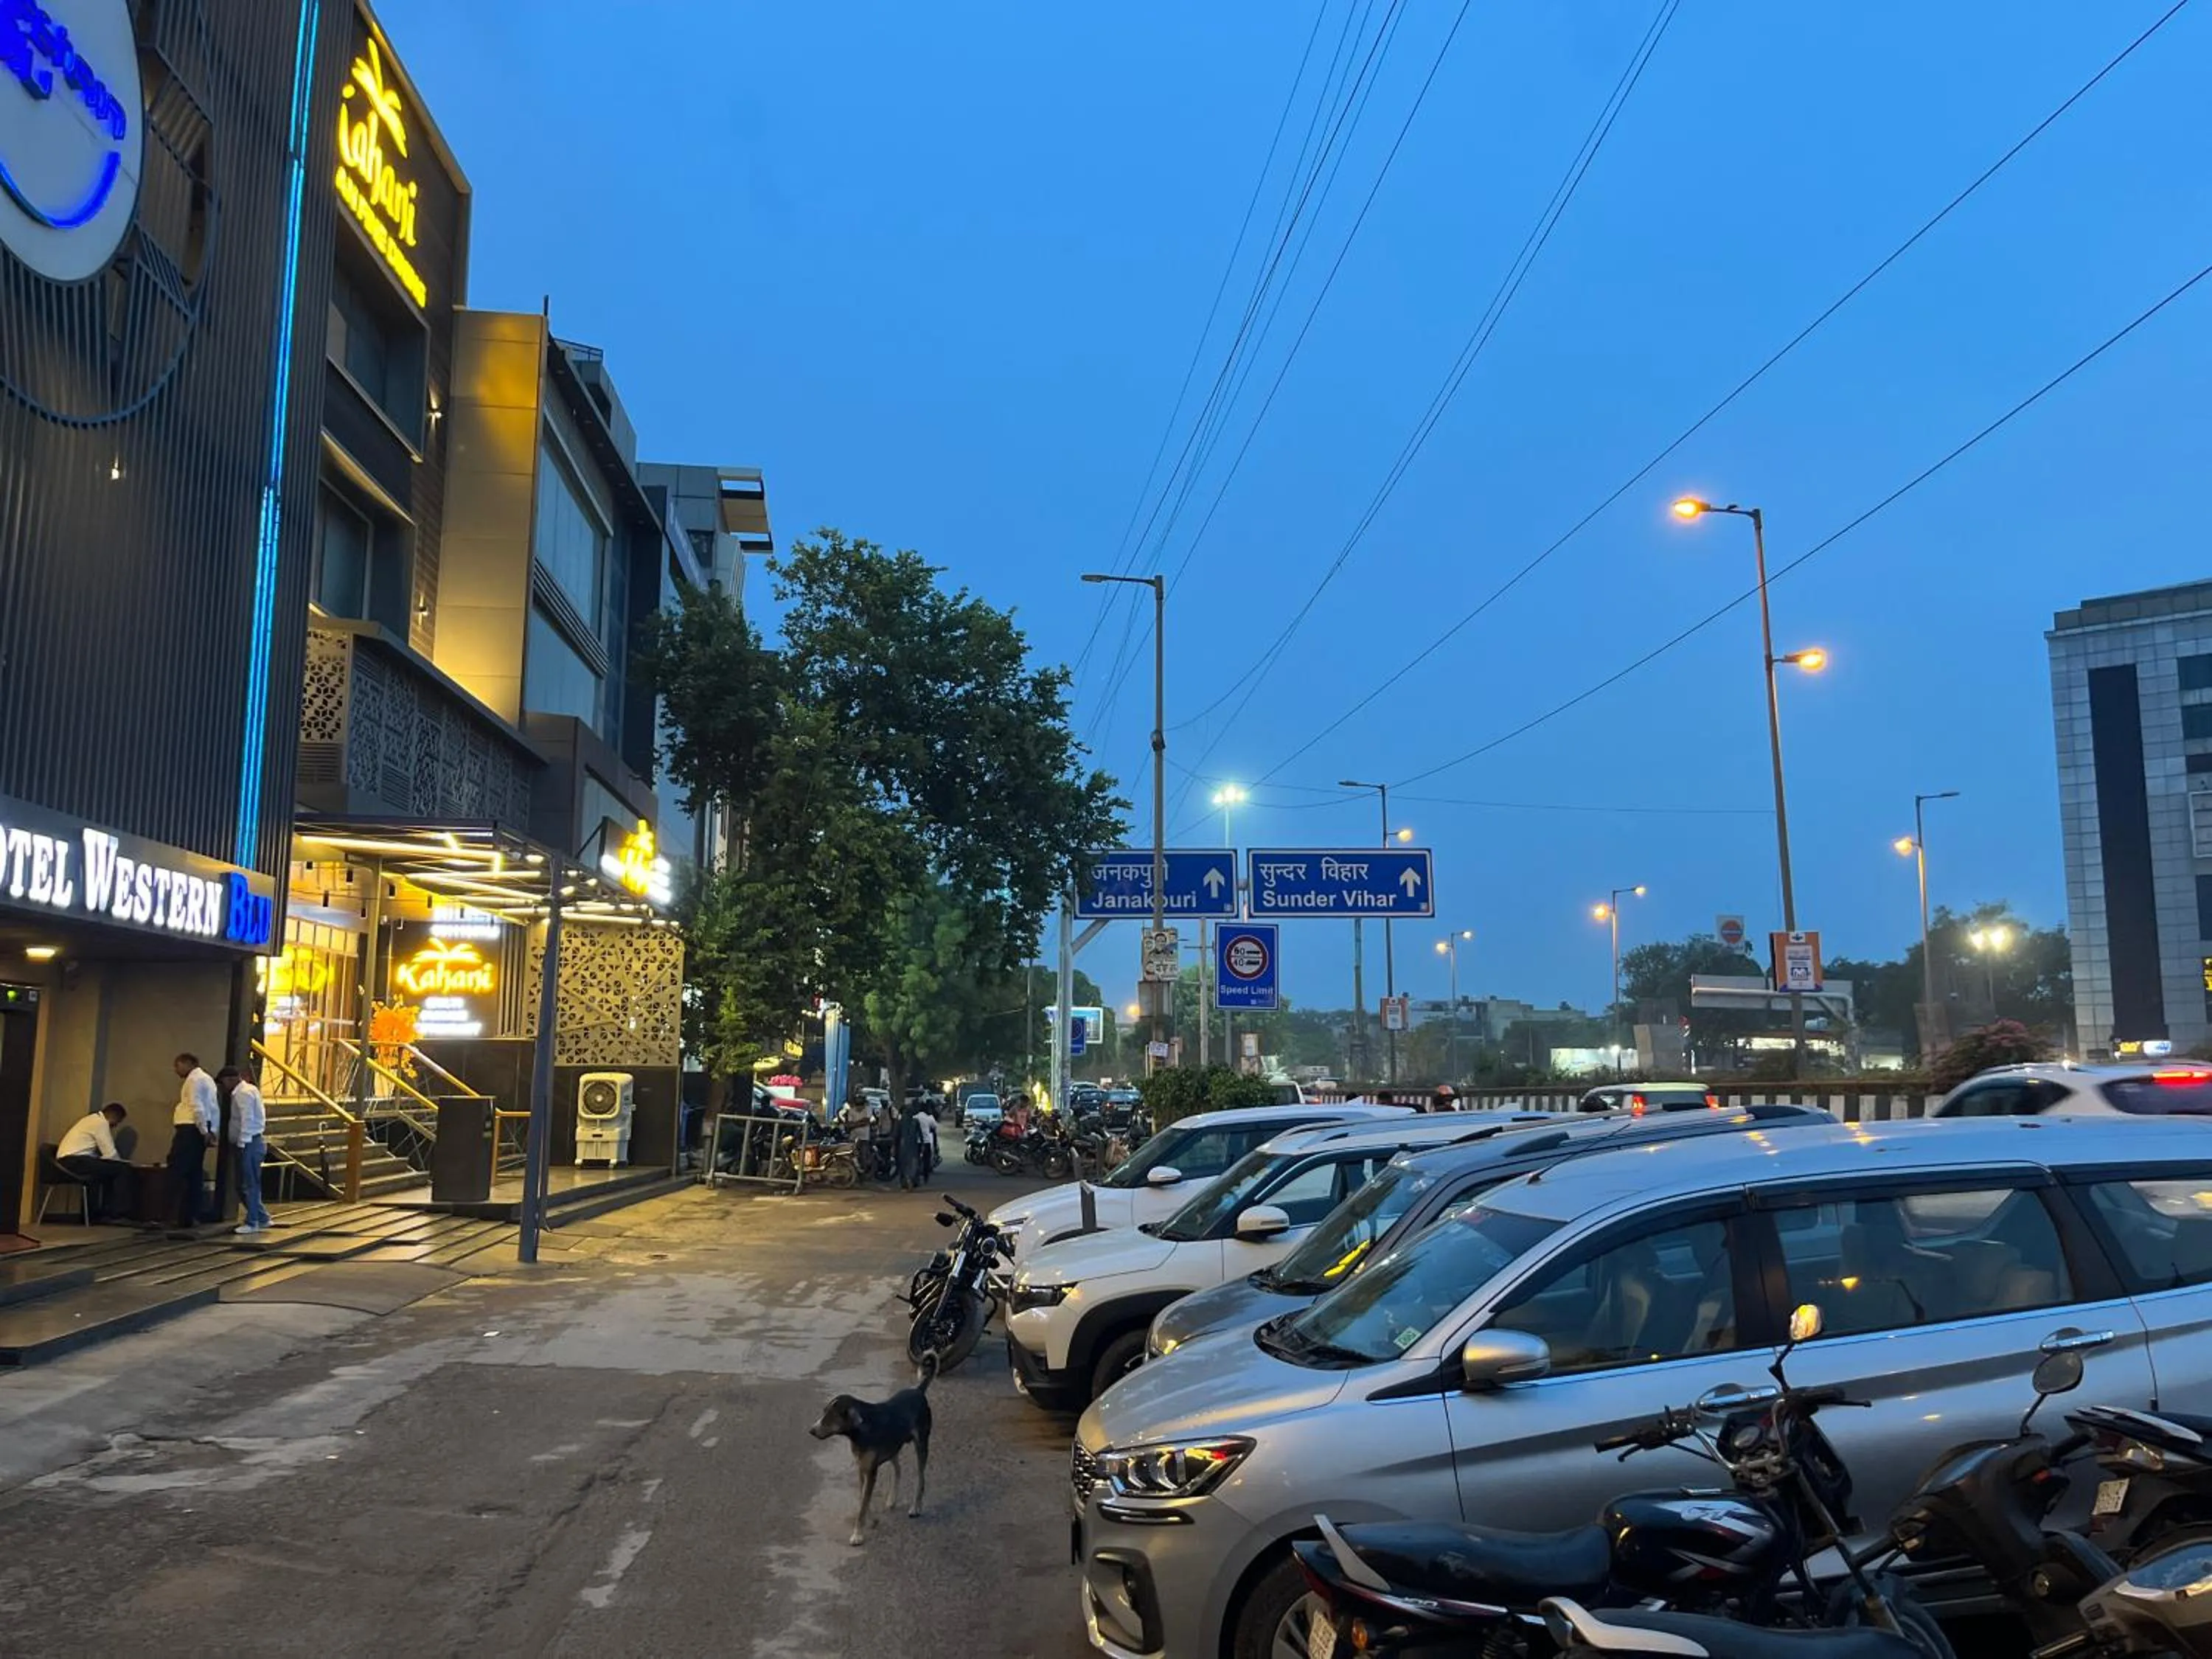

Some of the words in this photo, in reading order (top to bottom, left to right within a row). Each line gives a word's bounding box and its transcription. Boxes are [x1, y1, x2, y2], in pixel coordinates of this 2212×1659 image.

[0, 823, 73, 908] TEL
[83, 827, 223, 939] WESTERN
[1091, 858, 1169, 888] जनकपुी
[1258, 863, 1307, 888] सुन्दर
[1321, 855, 1369, 883] विहार
[1262, 890, 1337, 908] Sunder
[1341, 890, 1397, 908] Vihar
[396, 961, 495, 995] Kahani
[1220, 984, 1248, 995] Speed
[1251, 986, 1273, 995] Limit
